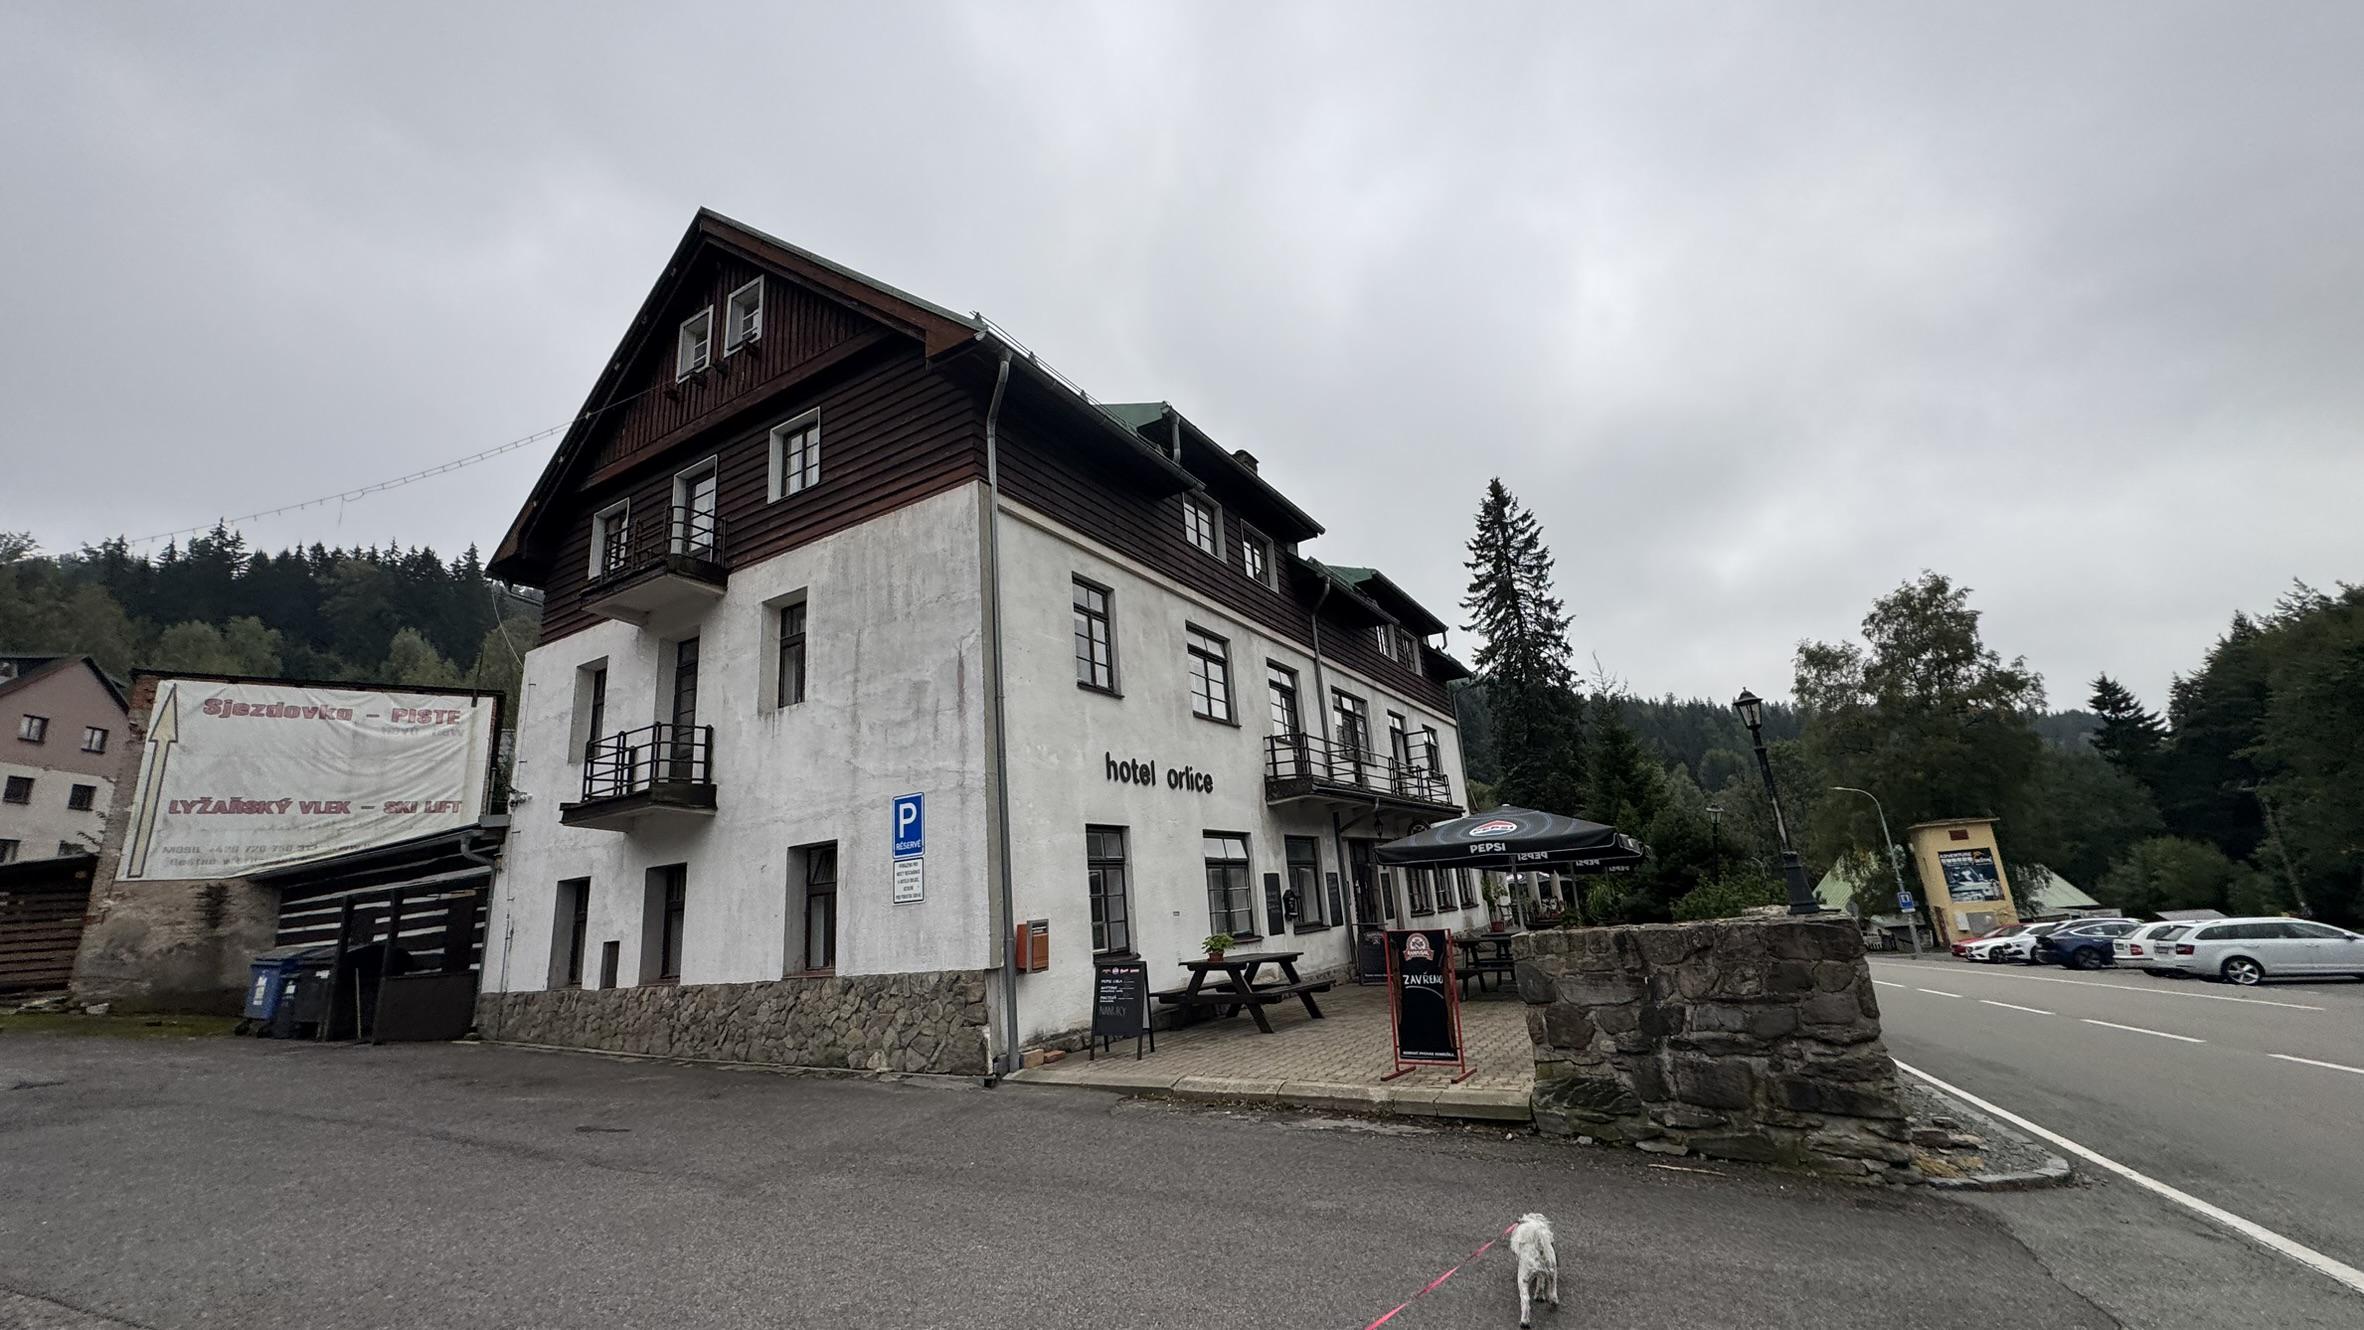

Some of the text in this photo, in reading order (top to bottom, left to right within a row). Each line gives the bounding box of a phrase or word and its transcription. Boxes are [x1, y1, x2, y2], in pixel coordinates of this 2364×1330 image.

[203, 698, 353, 721] Sjezdovka
[391, 707, 461, 725] PISTE
[1105, 751, 1214, 794] hotel orlice
[168, 797, 293, 815] LYŽAŘSKÝ
[300, 801, 351, 815] VLEK
[384, 801, 418, 814] SKI
[424, 801, 463, 814] LIFT
[899, 802, 917, 838] P
[1470, 842, 1506, 853] PEPSI
[1403, 972, 1443, 985] ZAVŘENO
